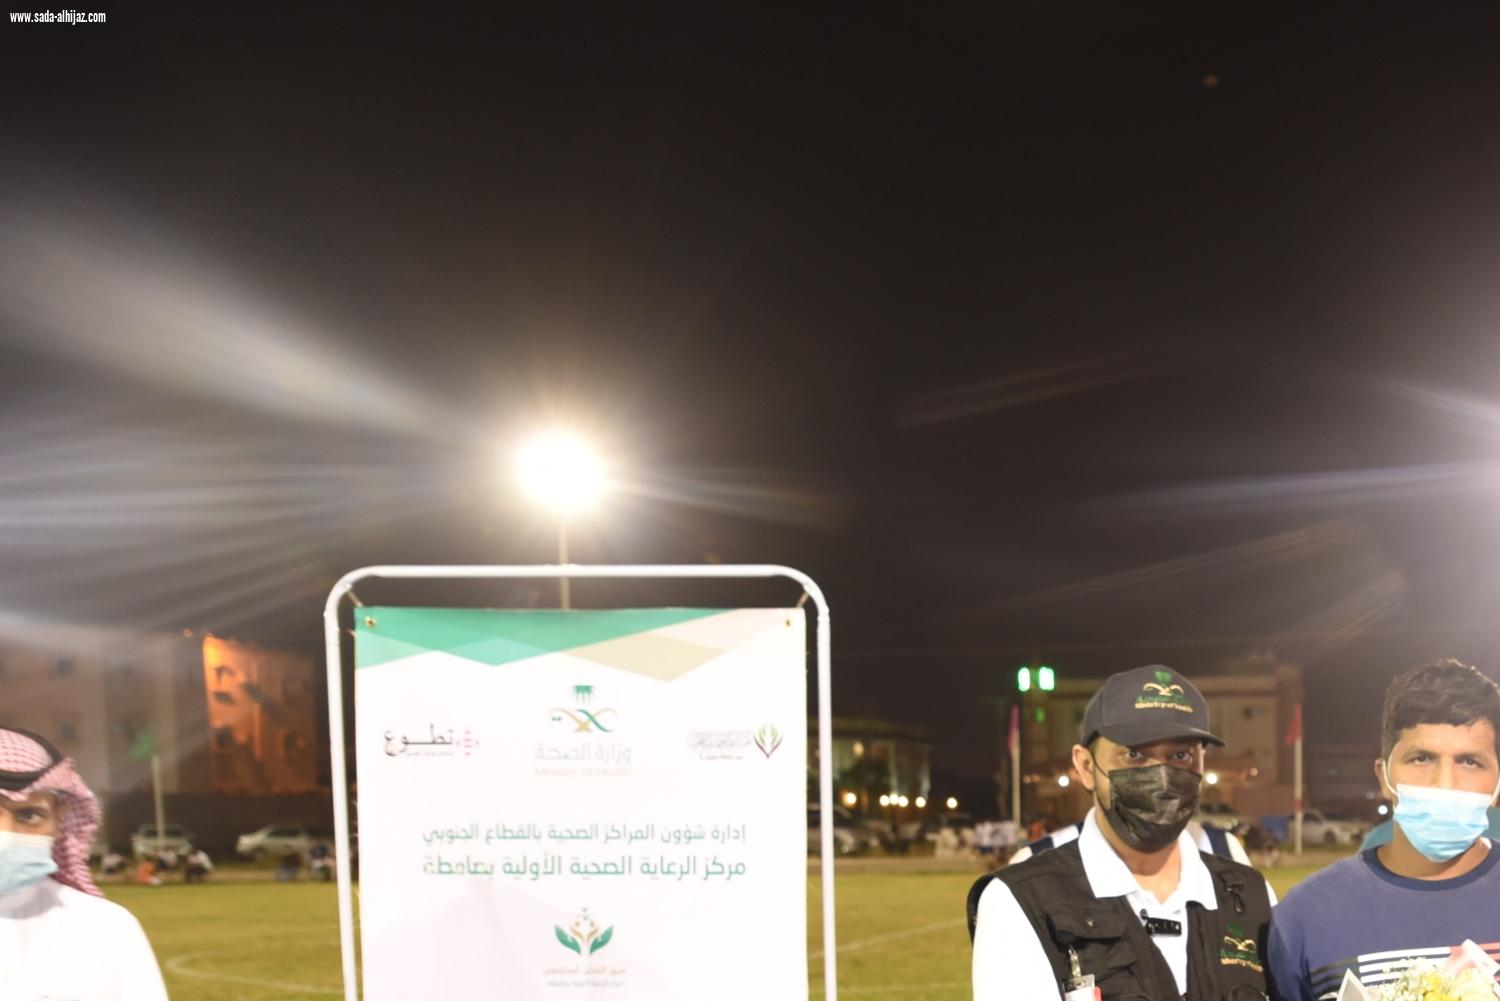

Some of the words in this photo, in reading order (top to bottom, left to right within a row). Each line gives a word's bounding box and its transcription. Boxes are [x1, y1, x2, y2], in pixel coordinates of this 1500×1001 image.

[534, 742, 591, 761] الصحة
[595, 742, 632, 765] وزارة
[422, 823, 480, 847] الجنوبي
[485, 823, 542, 846] بالقطاع
[547, 823, 599, 845] الصحية
[602, 823, 655, 845] المراكز
[660, 823, 706, 846] شؤون
[711, 823, 746, 846] إدارة
[502, 850, 562, 881] الأولية
[570, 855, 632, 881] الصحية
[640, 855, 697, 881] الرعاية
[703, 855, 746, 881] مركز
